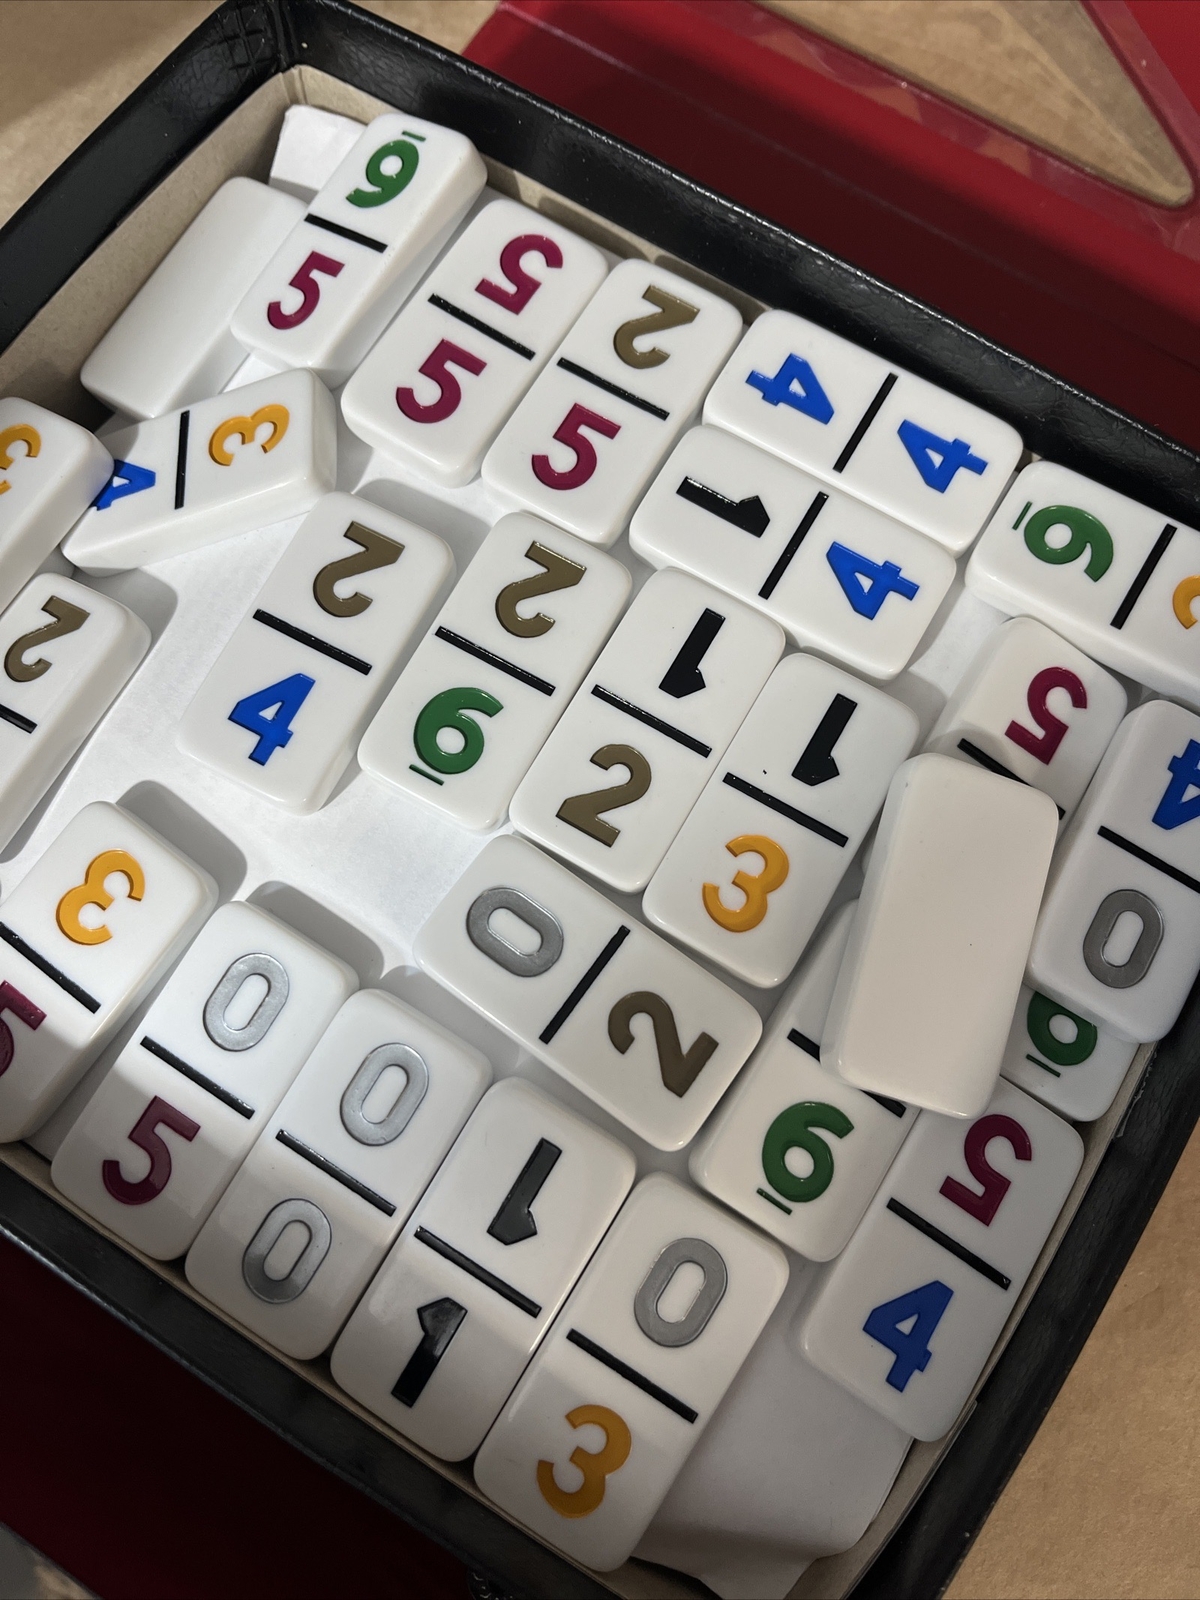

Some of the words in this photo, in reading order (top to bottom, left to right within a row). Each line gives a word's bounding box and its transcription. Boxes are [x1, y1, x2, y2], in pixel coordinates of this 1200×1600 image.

[345, 132, 426, 208] 6
[267, 251, 345, 330] 5
[474, 234, 564, 315] 5
[613, 284, 700, 369] 2
[396, 338, 488, 424] 5
[745, 352, 834, 425] 4
[209, 404, 290, 466] 3
[531, 402, 621, 491] 5
[897, 419, 988, 493] 4
[676, 476, 771, 538] 1
[1012, 501, 1114, 582] 6
[313, 521, 405, 618] 2
[495, 541, 587, 638] 2
[826, 541, 920, 620] 4
[4, 596, 90, 682] 2
[659, 608, 726, 698] 1
[228, 673, 316, 766] 4
[410, 687, 504, 785] 6
[792, 693, 858, 786] 1
[1004, 666, 1088, 765] 5
[556, 744, 652, 848] 2
[56, 849, 145, 945] 3
[702, 834, 790, 933] 3
[466, 887, 564, 978] 0
[1083, 889, 1165, 989] 0
[203, 952, 290, 1052] 0
[607, 990, 719, 1098] 2
[339, 1042, 430, 1146] 0
[102, 1096, 201, 1206] 5
[487, 1137, 562, 1246] 1
[756, 1101, 855, 1216] 6
[938, 1113, 1032, 1227] 5
[241, 1198, 332, 1304] 0
[633, 1237, 728, 1348] 0
[391, 1297, 468, 1407] 1
[862, 1280, 954, 1393] 4
[536, 1404, 632, 1518] 3
